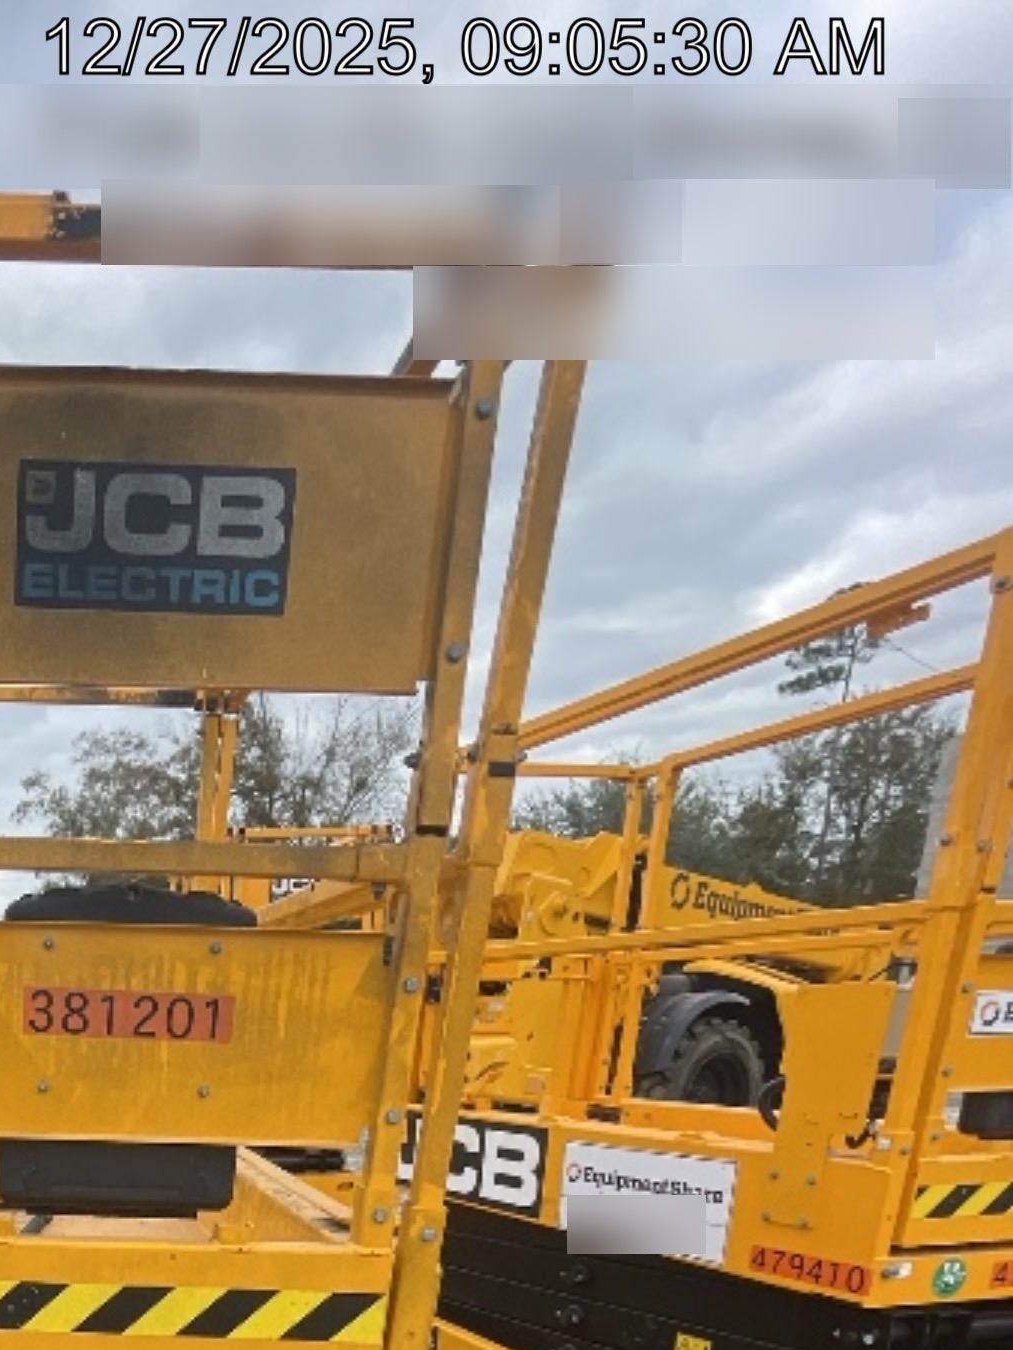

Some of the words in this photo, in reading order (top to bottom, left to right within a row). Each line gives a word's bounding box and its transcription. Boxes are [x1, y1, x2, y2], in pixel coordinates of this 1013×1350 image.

[25, 469, 285, 558] JCB
[22, 563, 280, 607] ELECTRIC
[28, 989, 219, 1039] 381201
[751, 1247, 865, 1294] 479410
